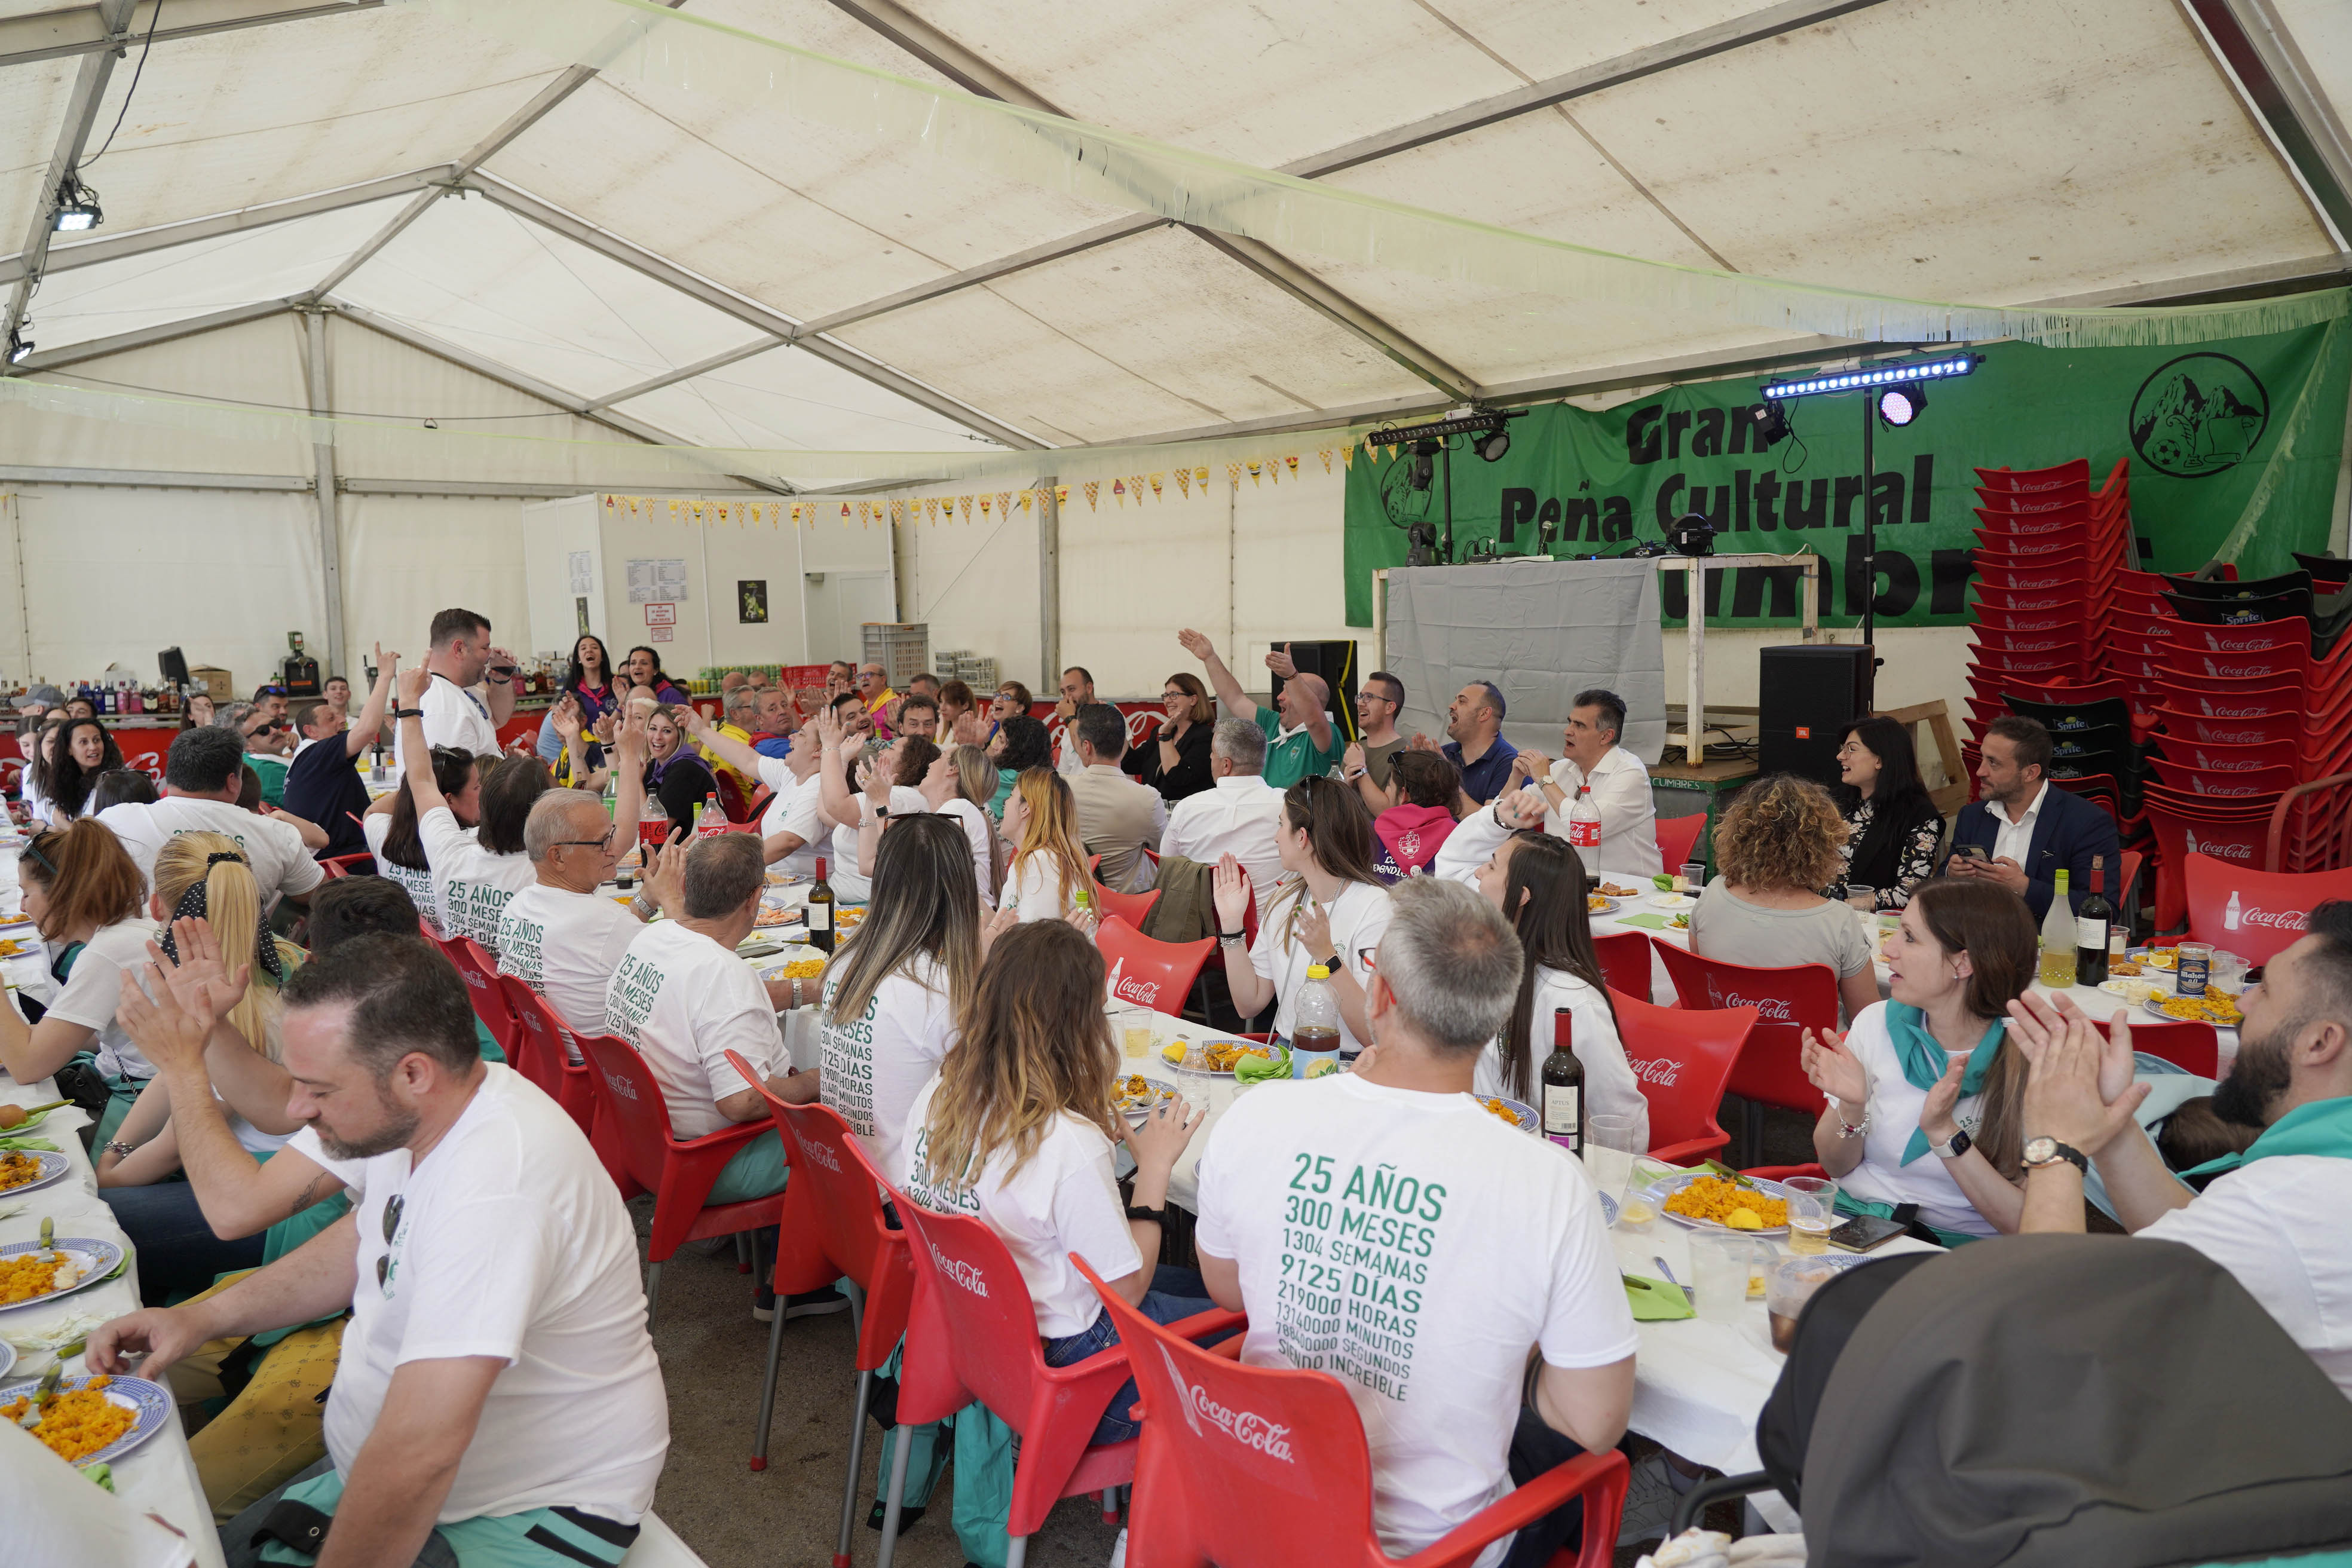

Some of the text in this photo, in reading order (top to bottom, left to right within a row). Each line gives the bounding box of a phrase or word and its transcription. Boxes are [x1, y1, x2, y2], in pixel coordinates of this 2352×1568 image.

[1627, 402, 1770, 465] Gran
[1499, 454, 1933, 543] Peña Cultural
[2227, 613, 2260, 625] Sprite
[2057, 721, 2085, 731] Sprite
[2212, 730, 2265, 743] Coca-Cola
[2053, 746, 2082, 756] Sprite
[1653, 777, 1700, 790] CUMBRES
[2200, 841, 2253, 859] Coca-Cola
[448, 880, 514, 907] 25 AÑOS
[418, 903, 436, 915] ÍAS
[448, 899, 503, 923] 300 MESE
[448, 912, 465, 925] 1304
[468, 918, 499, 933] SEMAN
[500, 917, 544, 944] 25 AÑOS
[509, 941, 542, 960] MESES
[620, 953, 664, 994] 25 AÑOS
[2180, 970, 2206, 979] Mahou
[614, 976, 654, 1012] 300 MESES
[1117, 976, 1162, 1004] Coca-Cola
[822, 1030, 872, 1061] 304 SEMANAS
[840, 1057, 873, 1080] DÍAS
[839, 1075, 873, 1095] HORAS
[838, 1104, 874, 1122] SEGUNDOS
[839, 1090, 873, 1109] MINUTOS
[1960, 1116, 1973, 1128] 25
[797, 1129, 841, 1173] Coca-Cola
[907, 1186, 932, 1208] 1304
[1290, 1153, 1447, 1222] 25 AÑOS
[1285, 1195, 1435, 1257] 300 MESES
[1283, 1227, 1428, 1285] 1304 SEMANAS
[932, 1243, 989, 1297] Coca-Cola
[1281, 1254, 1423, 1313] 9125 DÍAS
[1278, 1280, 1418, 1338] 219000 HORAS
[1276, 1301, 1414, 1359] 13140000 MINUTOS
[1278, 1339, 1408, 1402] SIENDO INCREÍBLE
[1343, 1338, 1410, 1379] SEGUNDOS
[1190, 1385, 1294, 1462] Coca-Cola
